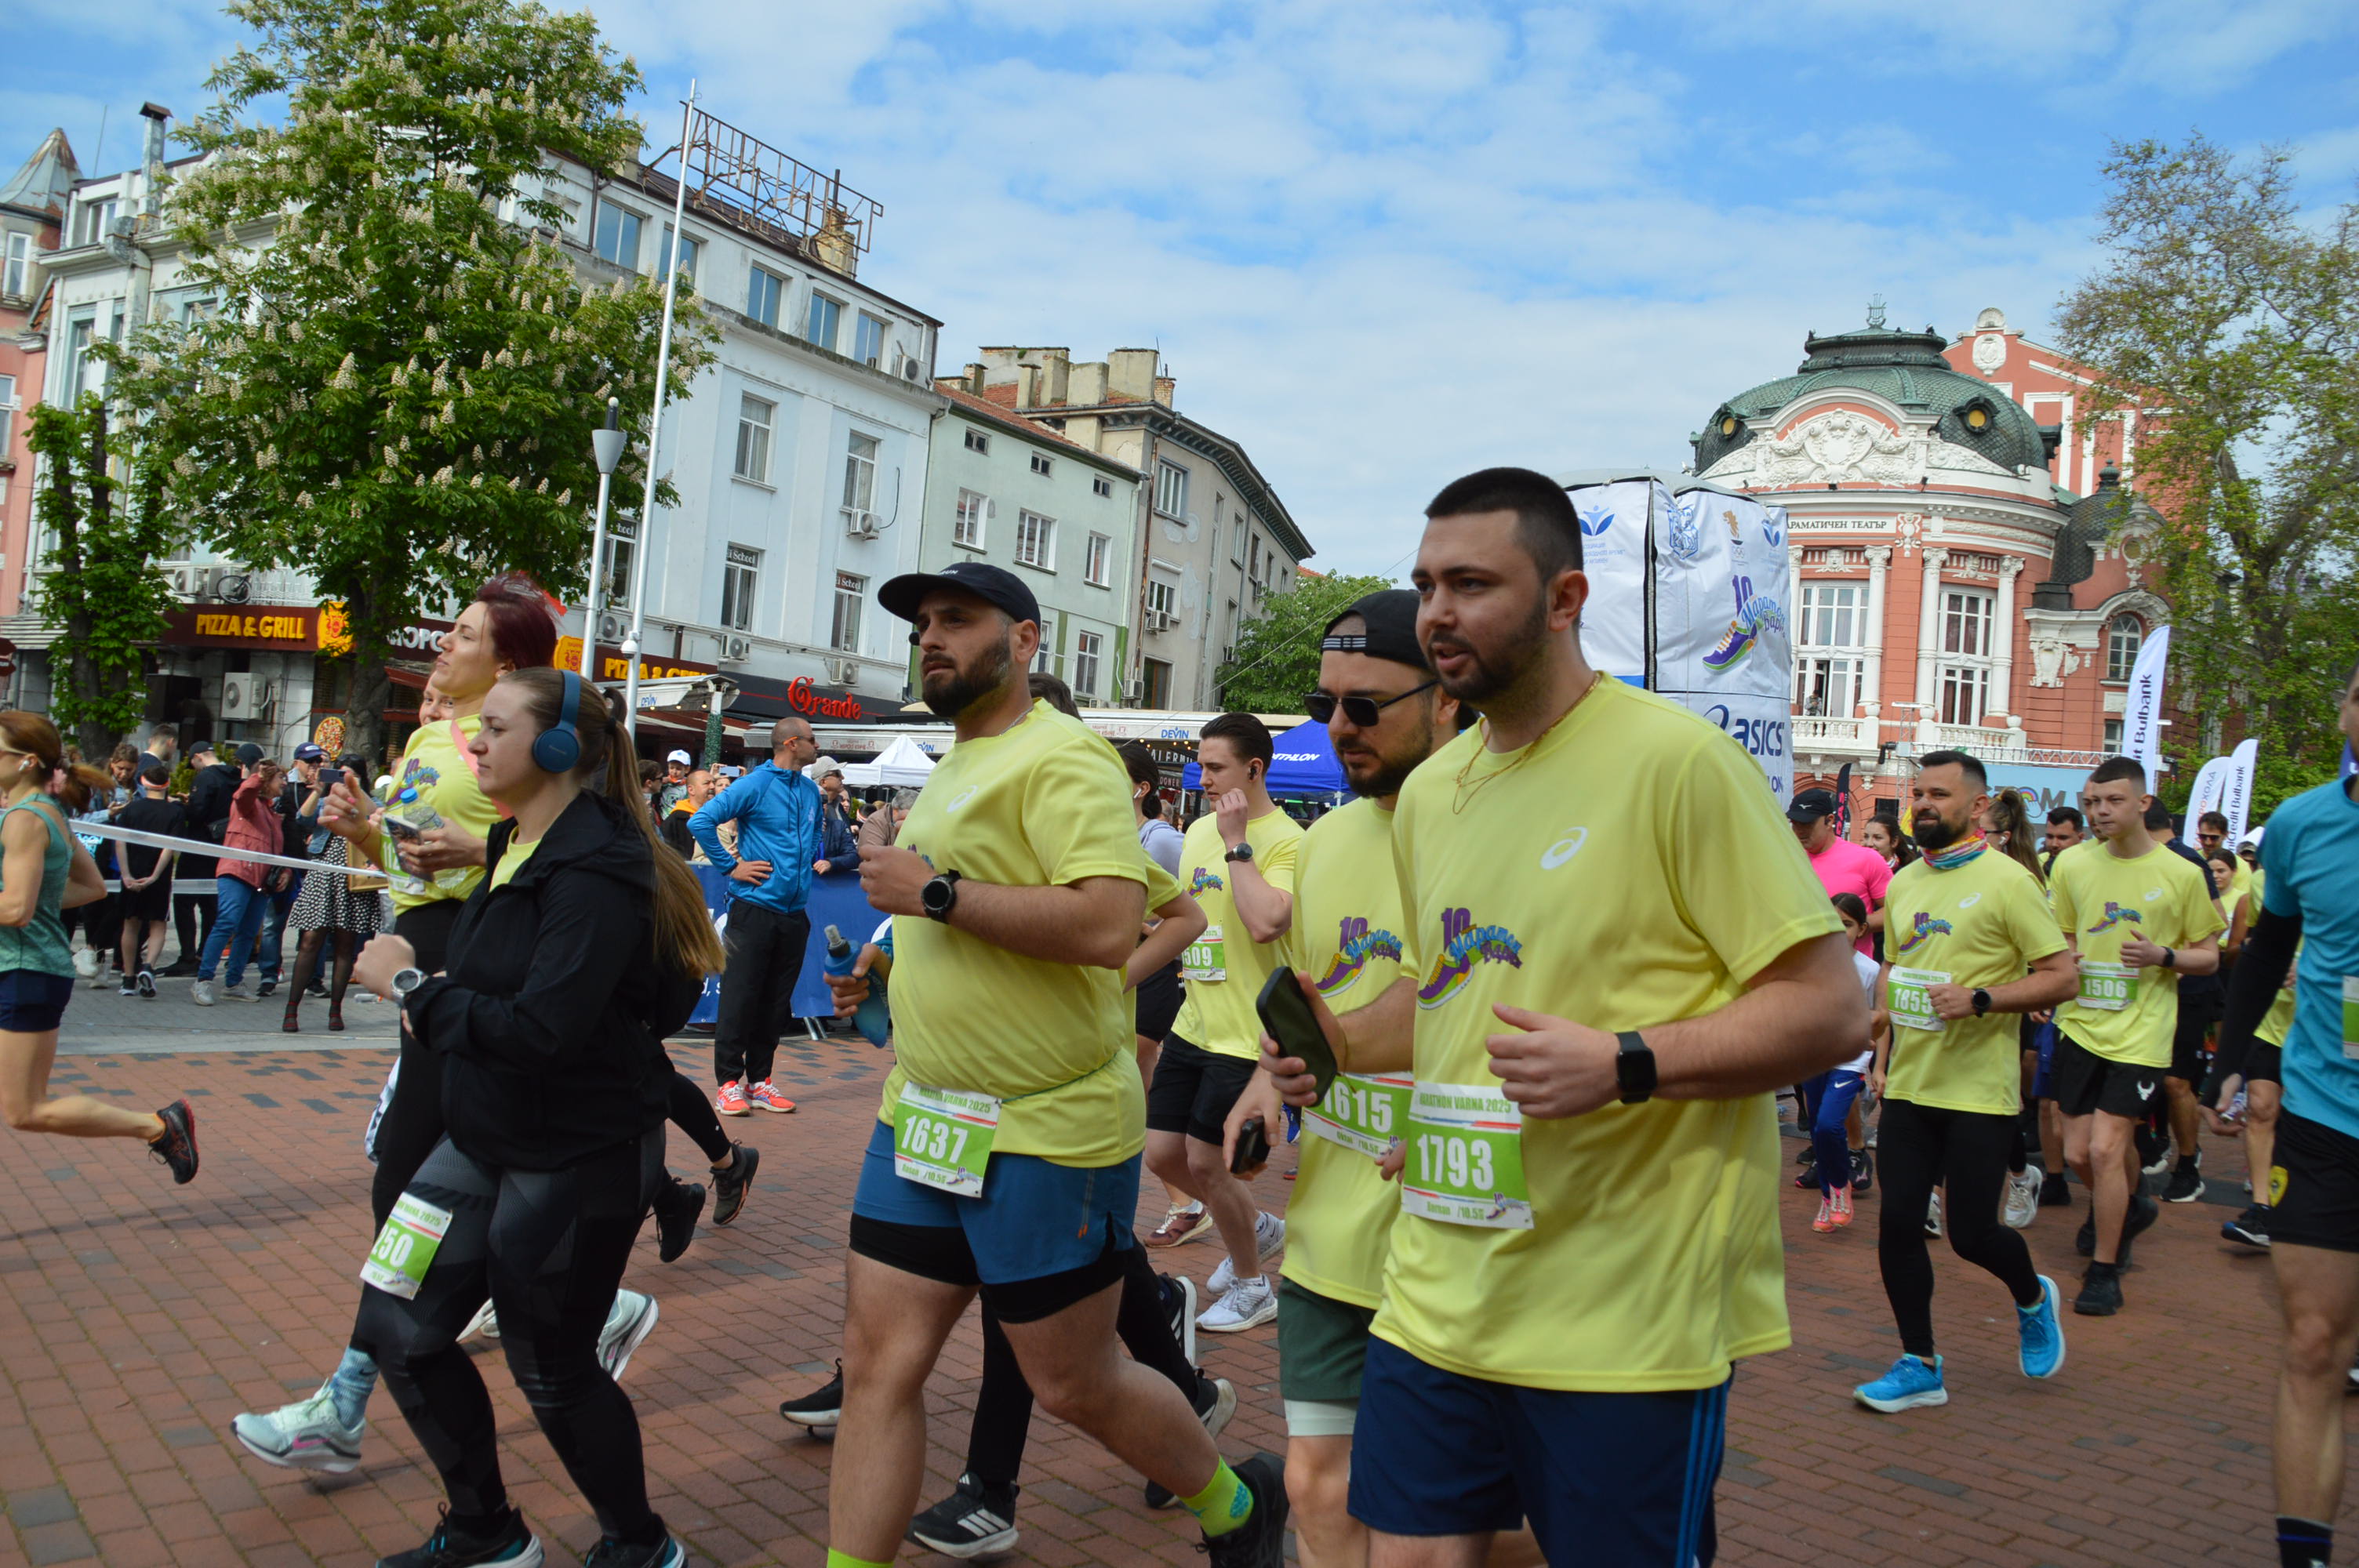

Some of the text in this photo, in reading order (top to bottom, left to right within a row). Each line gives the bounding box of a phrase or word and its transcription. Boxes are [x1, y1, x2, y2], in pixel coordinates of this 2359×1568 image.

[733, 550, 756, 564] School
[841, 578, 861, 590] School
[1732, 575, 1754, 618] 10
[195, 614, 307, 639] PIZZA & GRILL
[605, 658, 649, 680] PIZA
[787, 676, 862, 720] Grande
[2134, 673, 2152, 743] Bulbank
[1161, 728, 1190, 739] DEVIN
[917, 742, 935, 753] VIN
[2231, 766, 2245, 808] Bulbank
[1339, 916, 1368, 953] 10
[1441, 907, 1471, 953] 10
[1894, 988, 1933, 1014] 1855
[2084, 978, 2127, 998] 1506
[968, 1098, 992, 1114] 2025
[1324, 1081, 1392, 1133] 1615
[1454, 1097, 1485, 1112] VARNA
[1485, 1099, 1511, 1113] 2025
[901, 1115, 969, 1163] 1637
[1417, 1133, 1494, 1190] 1793
